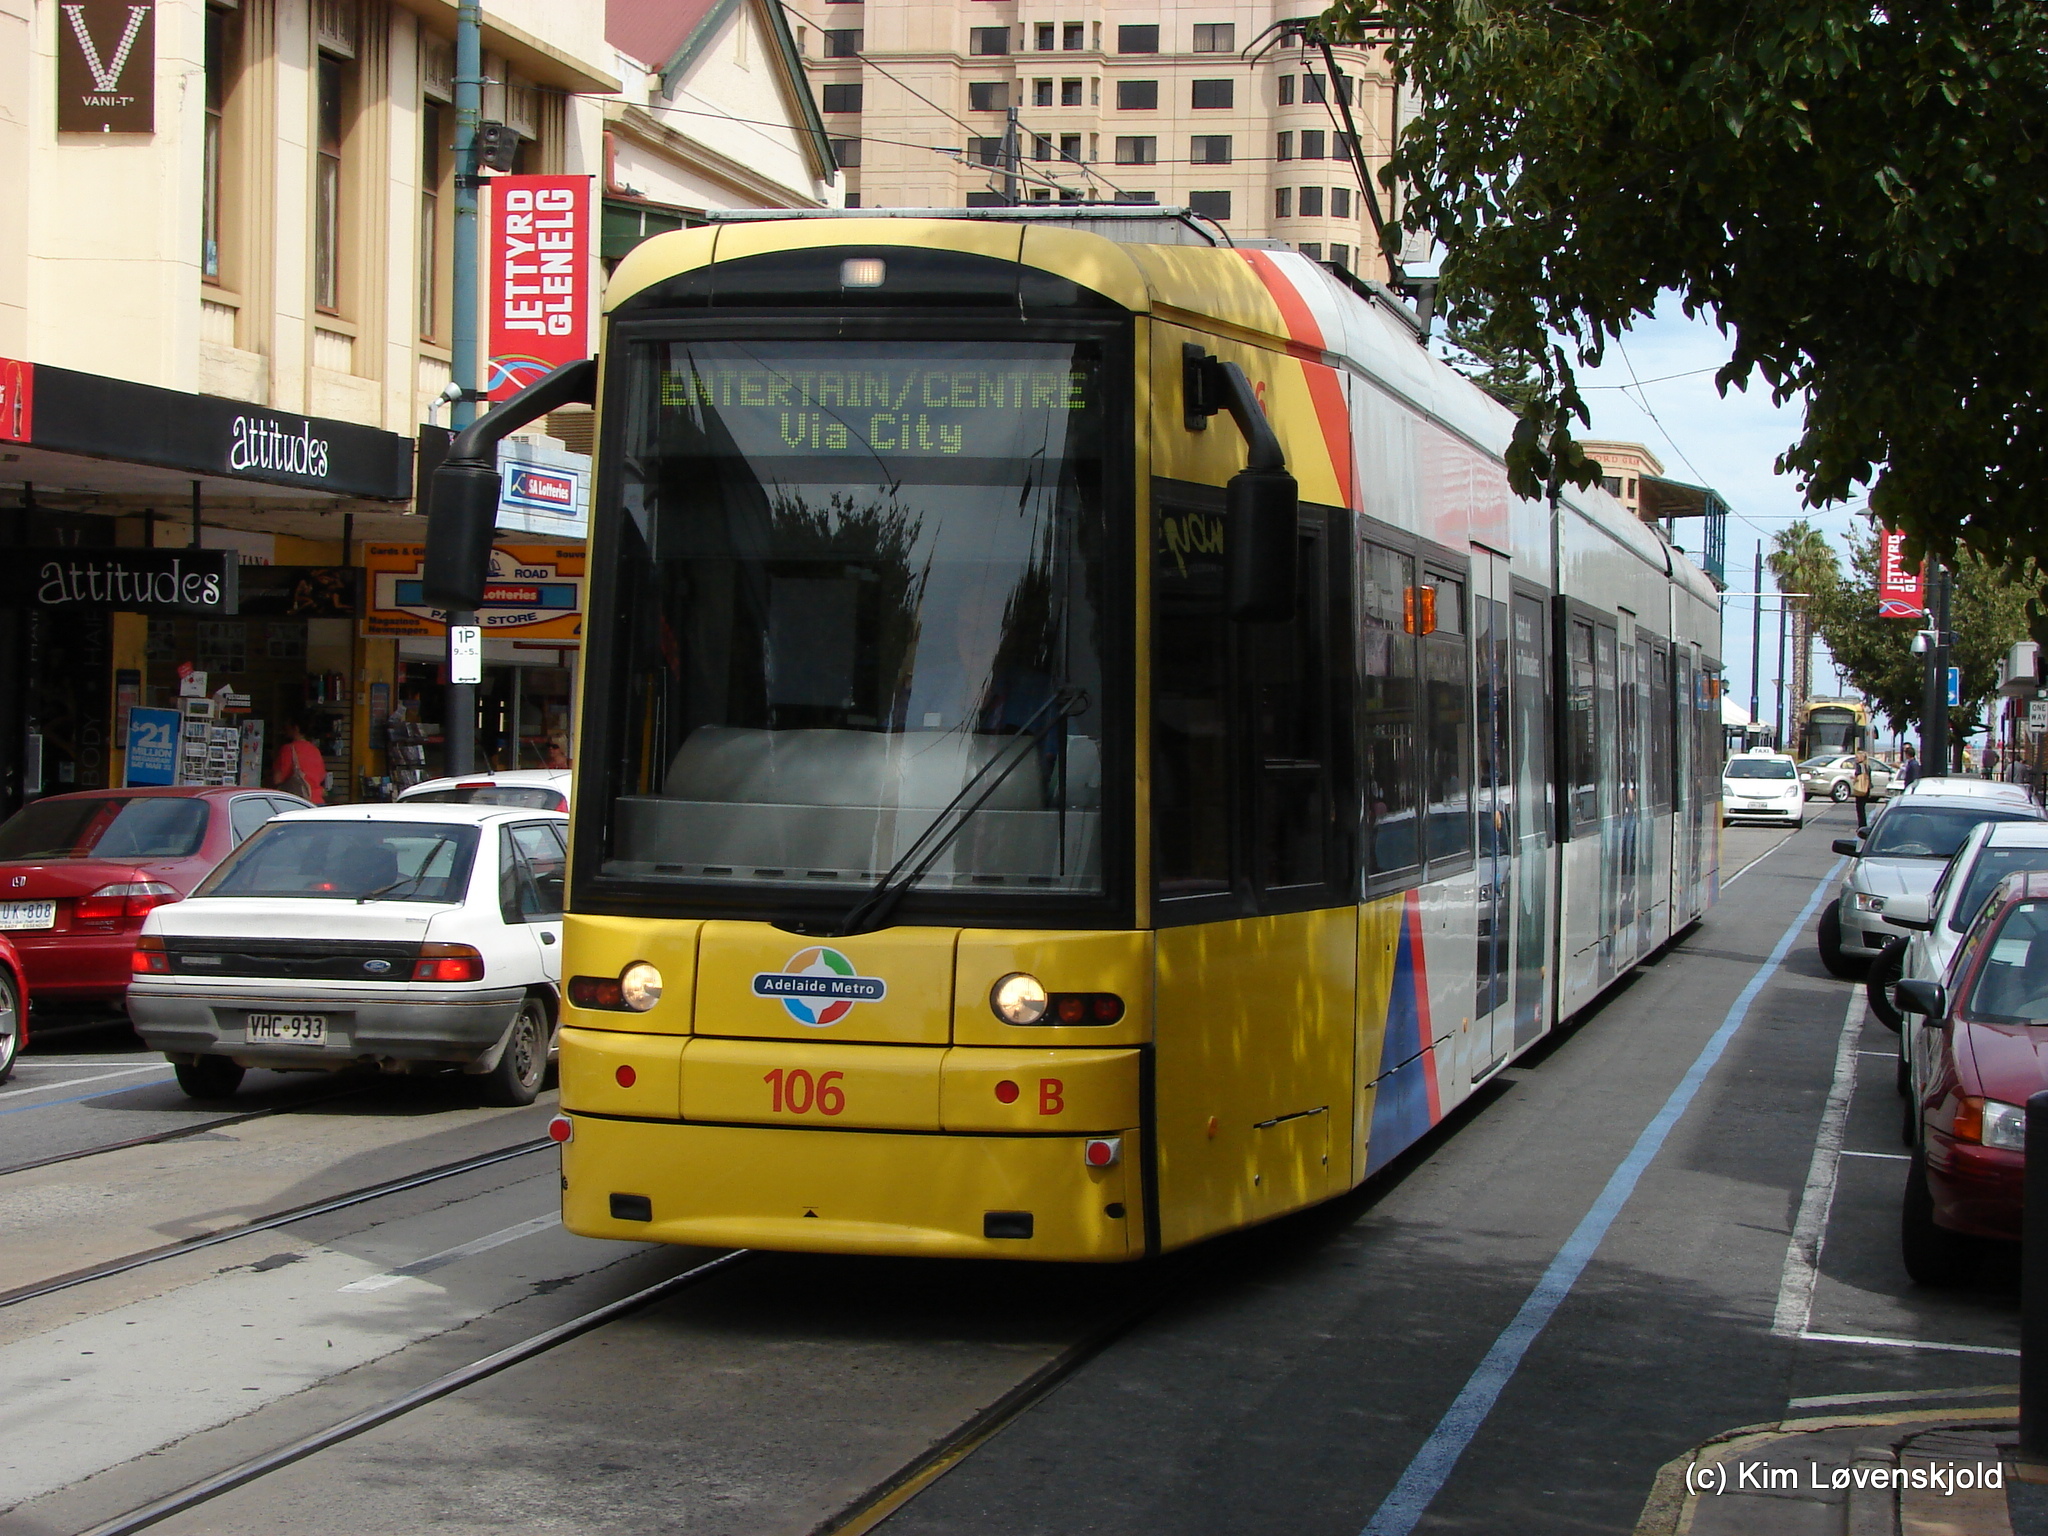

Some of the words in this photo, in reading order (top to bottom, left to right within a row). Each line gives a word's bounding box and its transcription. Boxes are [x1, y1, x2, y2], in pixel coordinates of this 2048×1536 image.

[61, 4, 151, 92] V
[505, 190, 546, 335] JETTYRD
[535, 189, 573, 335] GLENELG
[231, 415, 328, 478] attitudes
[780, 412, 847, 449] Via
[870, 413, 963, 454] City
[528, 478, 538, 495] SA
[539, 480, 569, 500] Lotteries
[38, 558, 220, 605] attitudes
[514, 568, 549, 579] ROAD
[368, 617, 421, 627] Magazines
[368, 626, 429, 636] Newspapers
[487, 611, 538, 625] STORE
[458, 630, 476, 644] 1P
[2032, 704, 2046, 712] ONE
[130, 721, 173, 749] $21
[764, 979, 827, 992] Adelaide
[831, 981, 875, 995] Metro
[763, 1068, 845, 1116] 106
[1039, 1078, 1064, 1115] B
